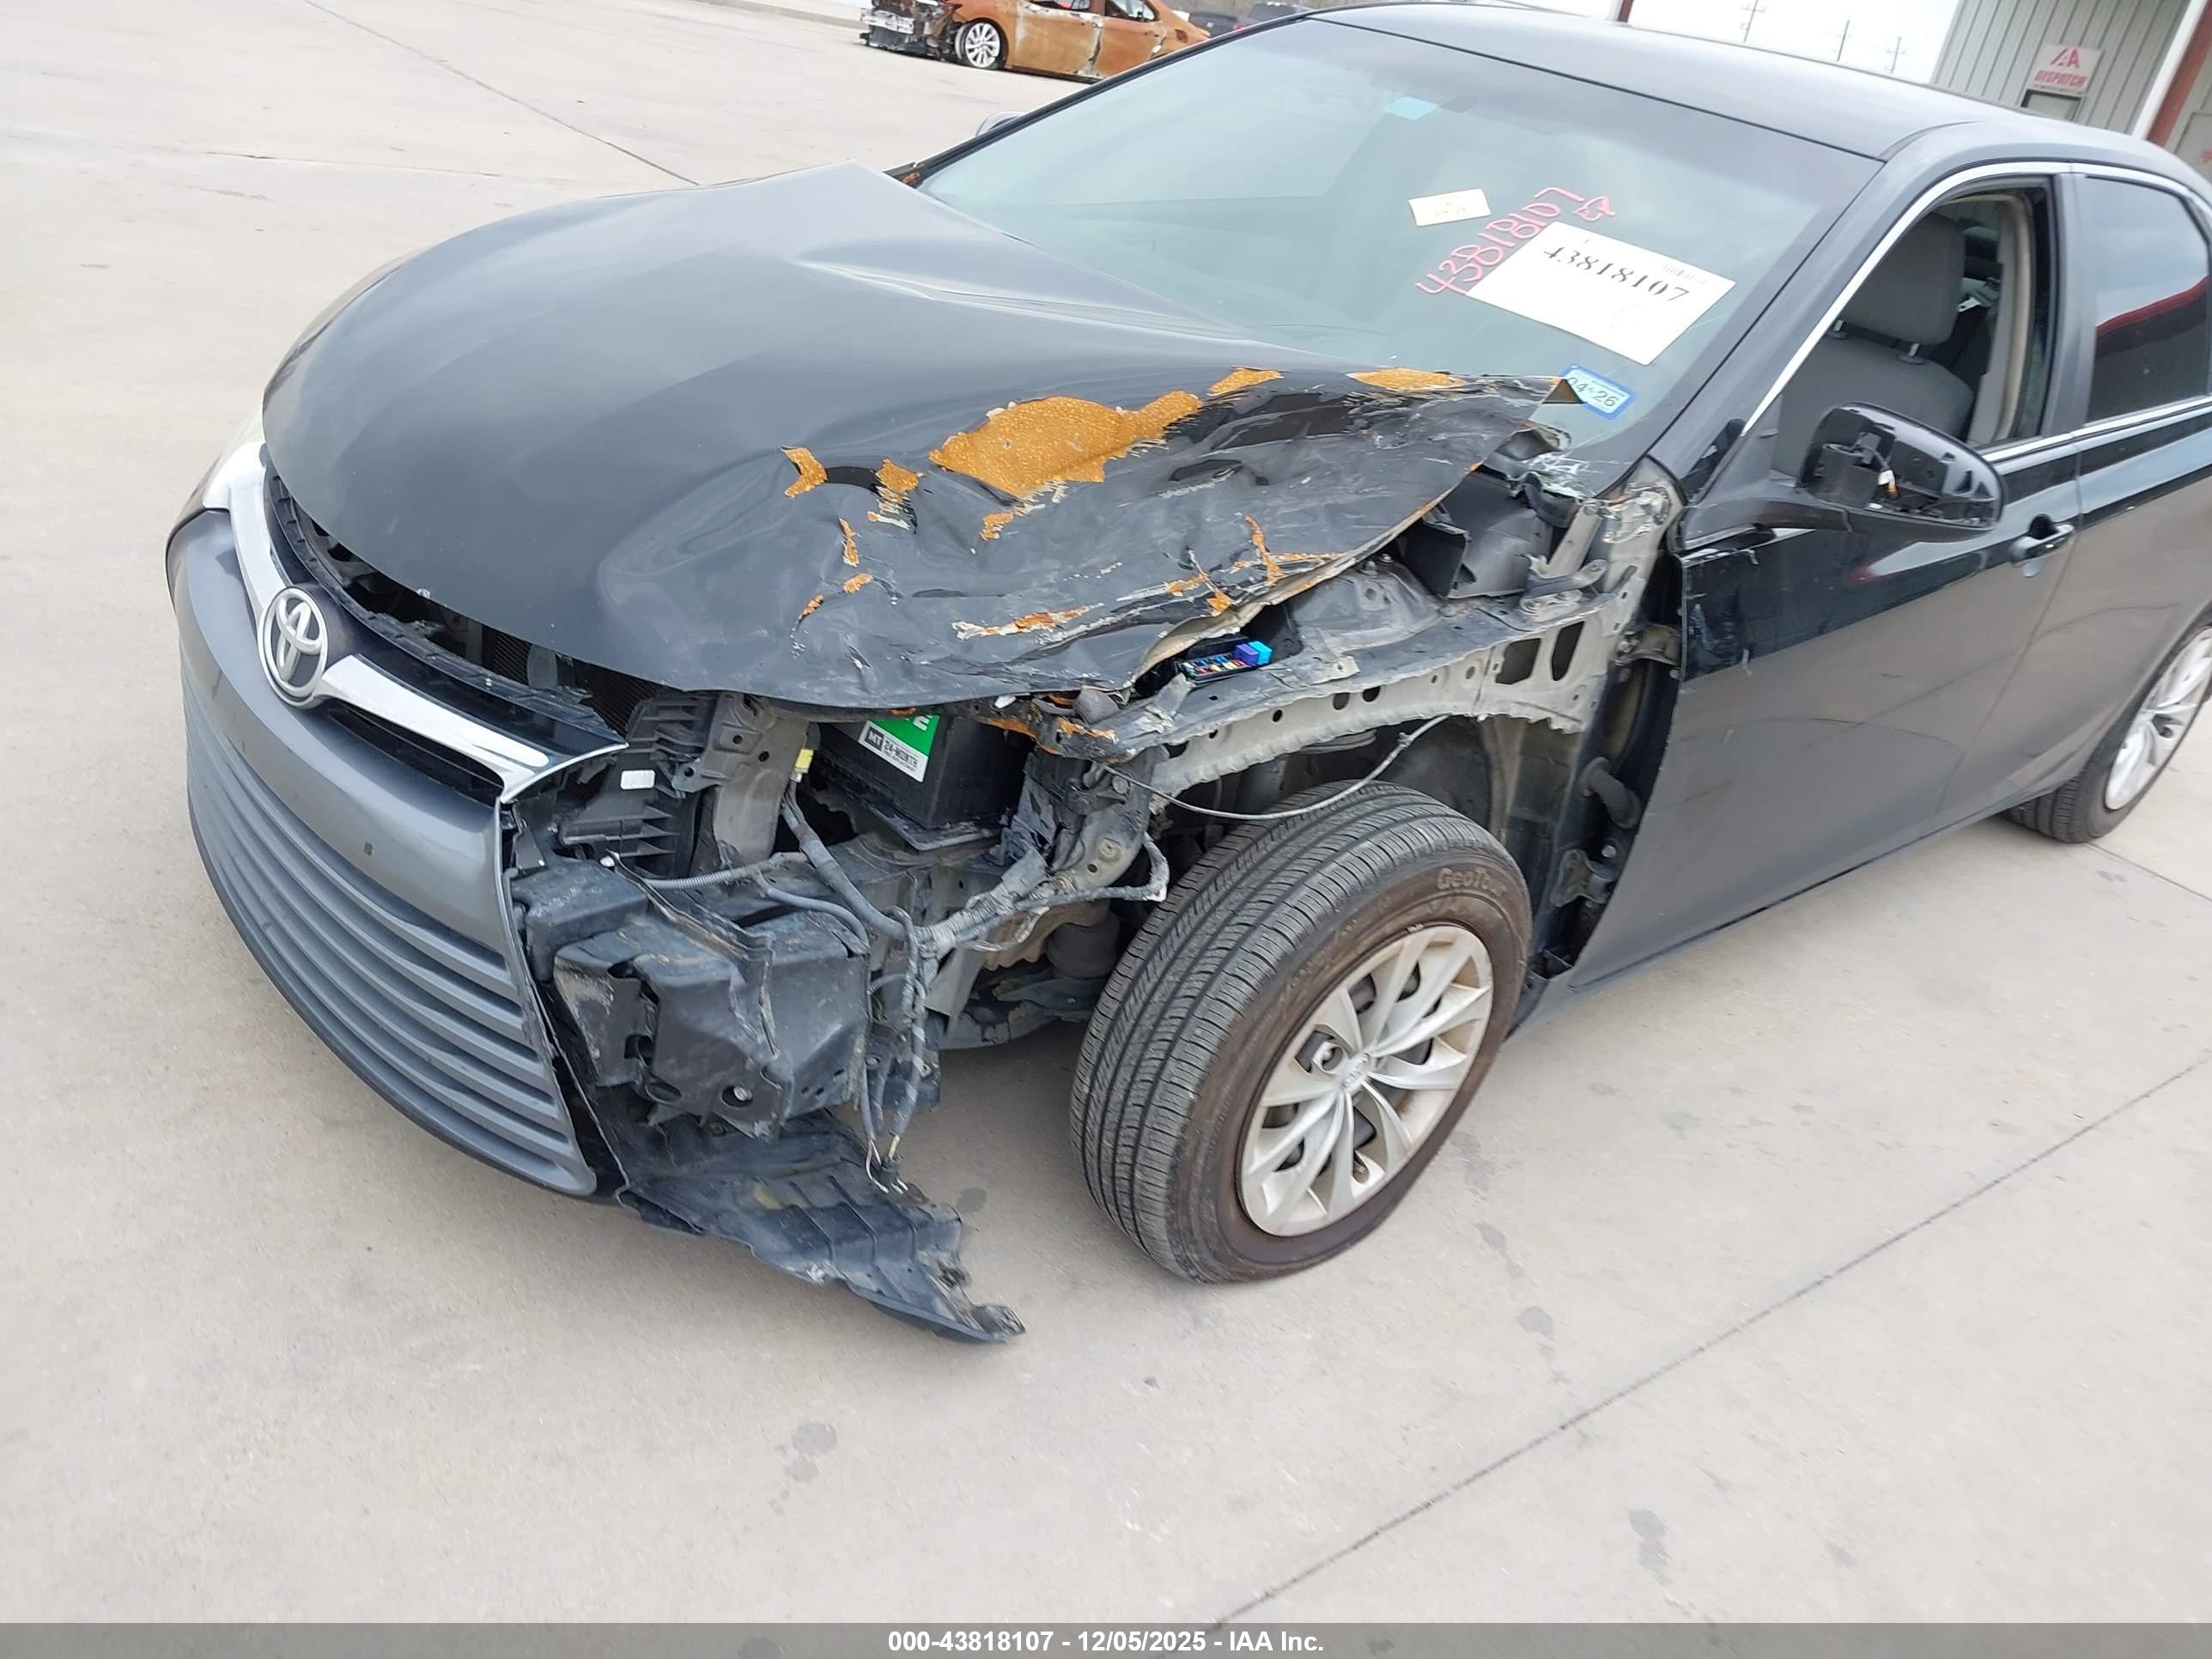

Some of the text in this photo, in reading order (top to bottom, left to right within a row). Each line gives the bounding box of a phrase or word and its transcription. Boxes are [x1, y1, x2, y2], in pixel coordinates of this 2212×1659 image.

[2034, 70, 2088, 88] DISPATCH
[1414, 186, 1585, 295] 43818107
[1543, 246, 1690, 302] 43818107
